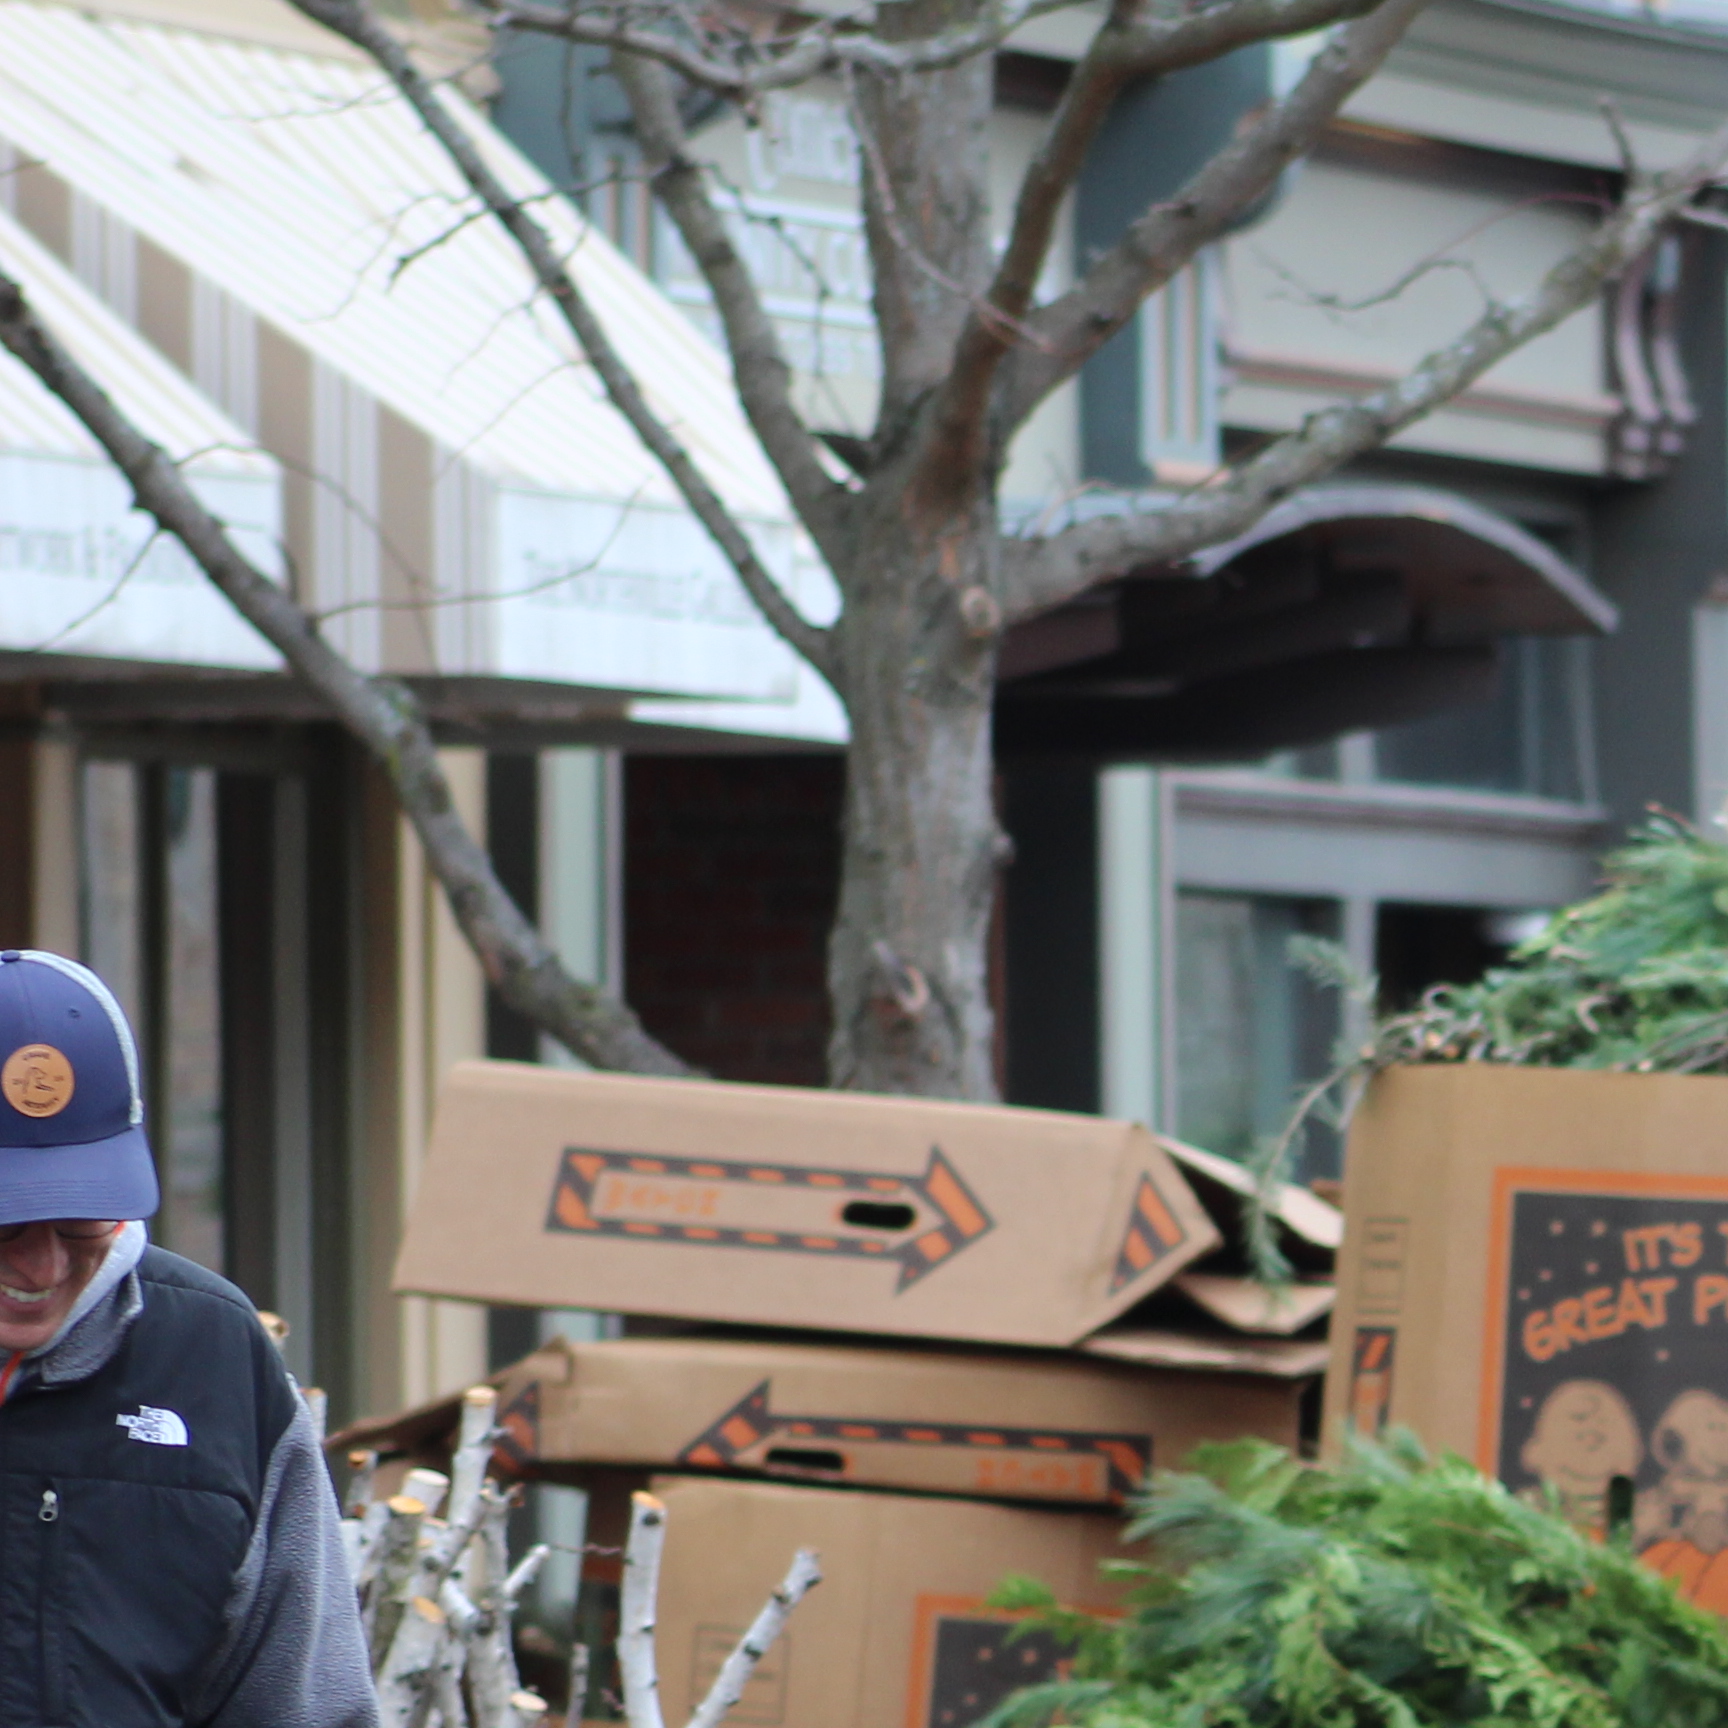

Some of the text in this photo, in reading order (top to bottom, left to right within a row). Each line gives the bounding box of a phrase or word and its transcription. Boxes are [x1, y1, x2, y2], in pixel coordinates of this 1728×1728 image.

[1522, 1277, 1678, 1364] GREAT
[115, 1414, 161, 1432] NORTH
[127, 1429, 162, 1443] FACE
